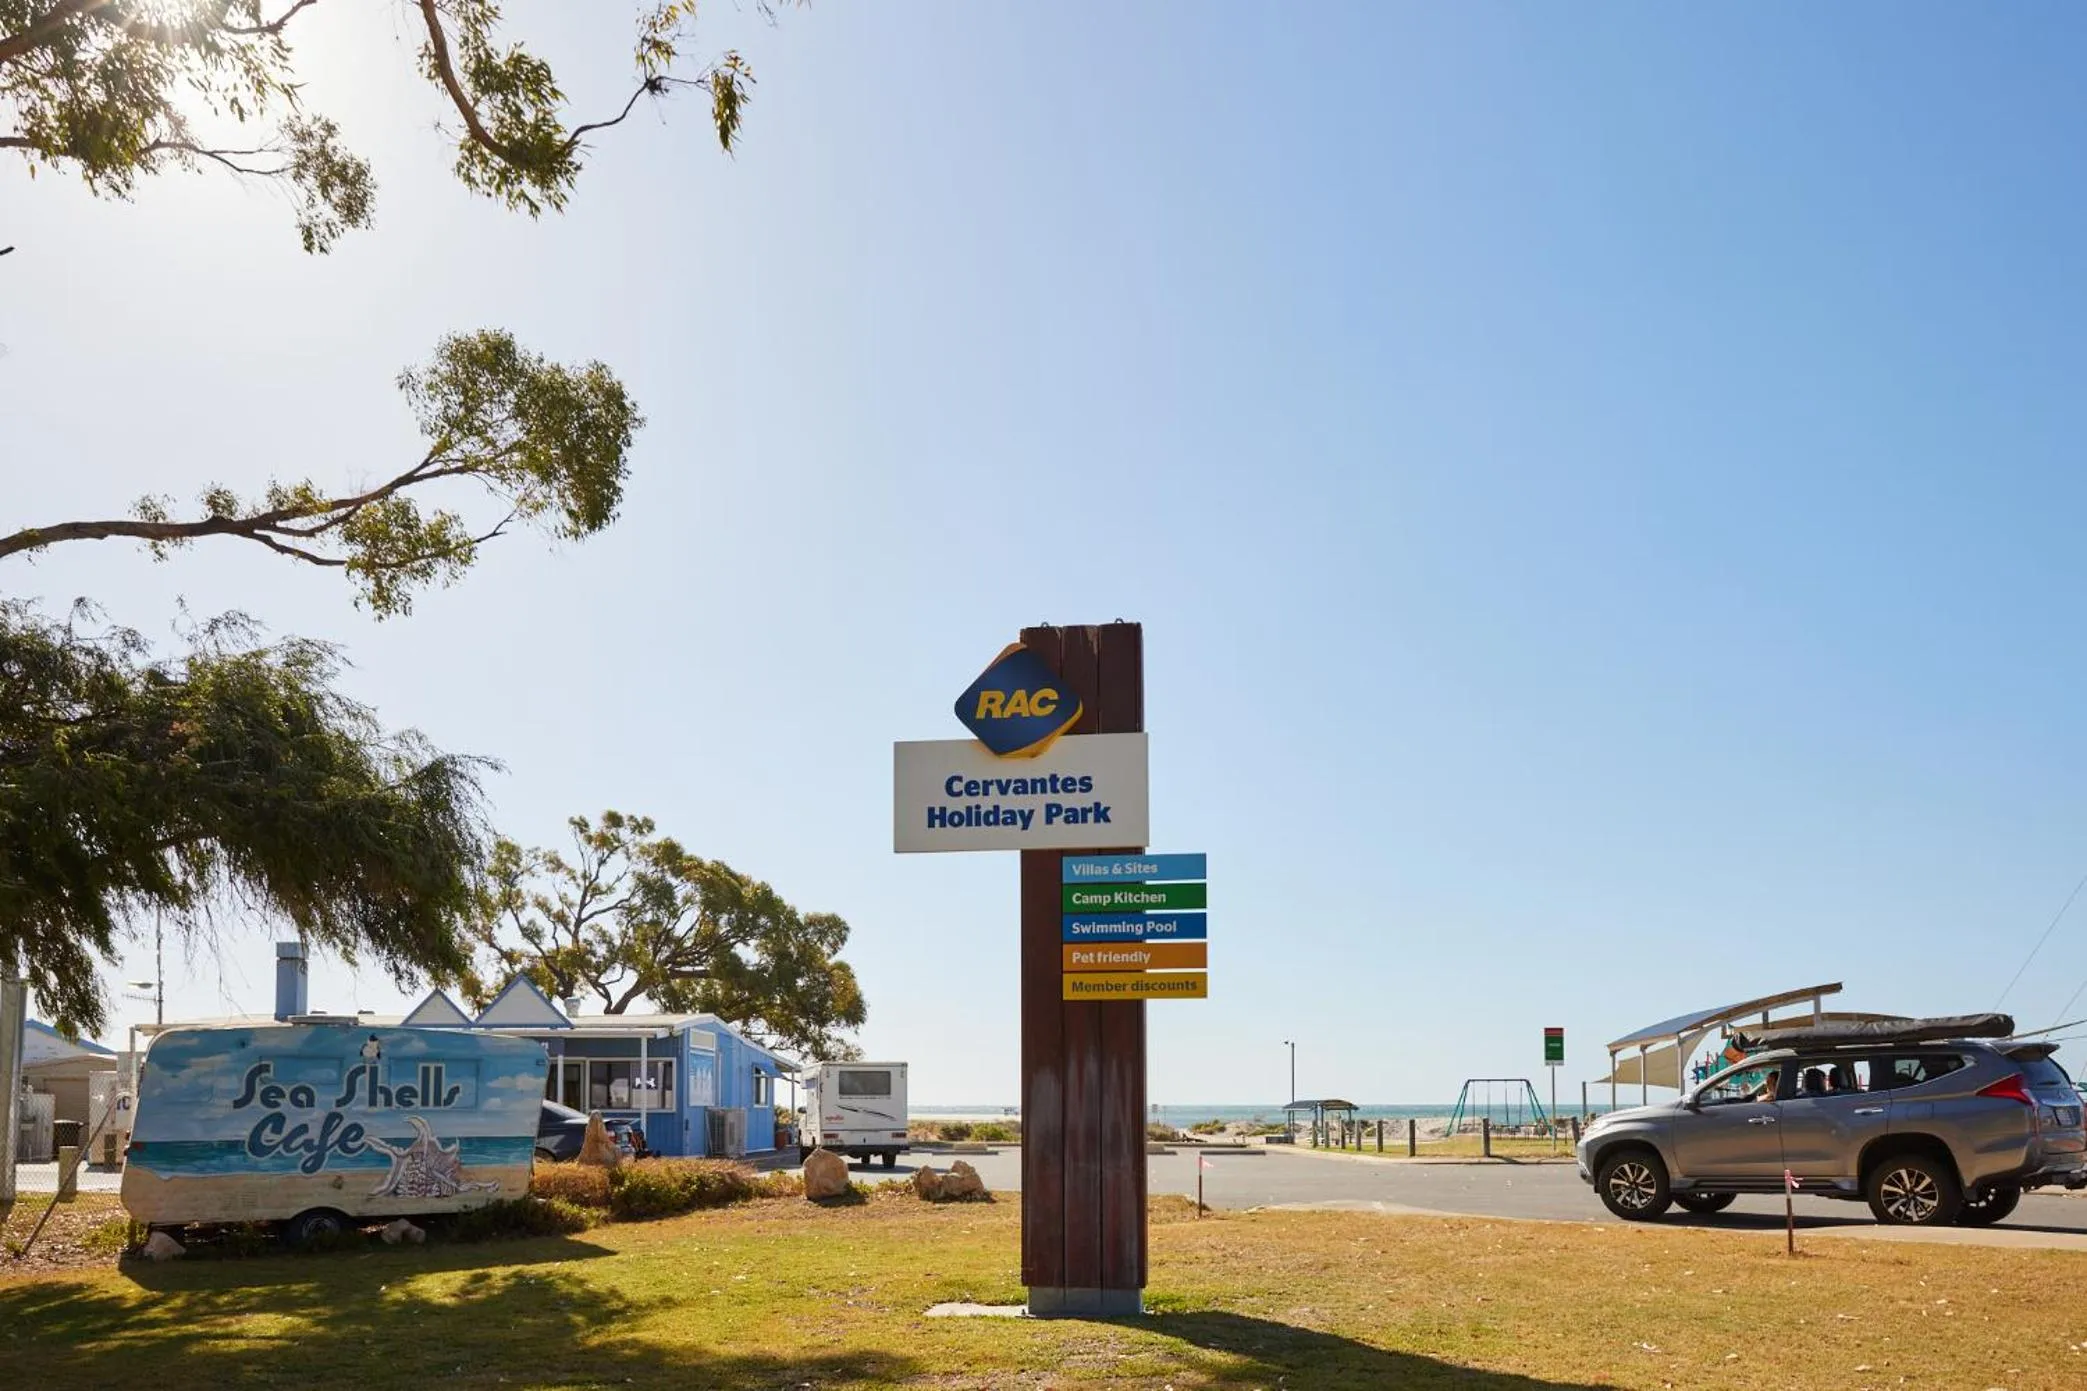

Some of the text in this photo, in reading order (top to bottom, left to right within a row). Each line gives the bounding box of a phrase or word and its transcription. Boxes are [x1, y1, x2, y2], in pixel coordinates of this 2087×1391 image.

[975, 687, 1058, 720] RAC
[944, 773, 1094, 798] Cervantes
[926, 802, 1112, 831] Holiday Park
[1072, 861, 1158, 876] Villas & Sites
[1072, 891, 1167, 907] Camp Kitchen
[1072, 920, 1177, 935] Swimming Pool
[1072, 951, 1151, 965] Pet friendly
[1072, 979, 1198, 993] Member discounts
[232, 1062, 461, 1109] Sea Shells
[248, 1110, 366, 1175] Cafe
